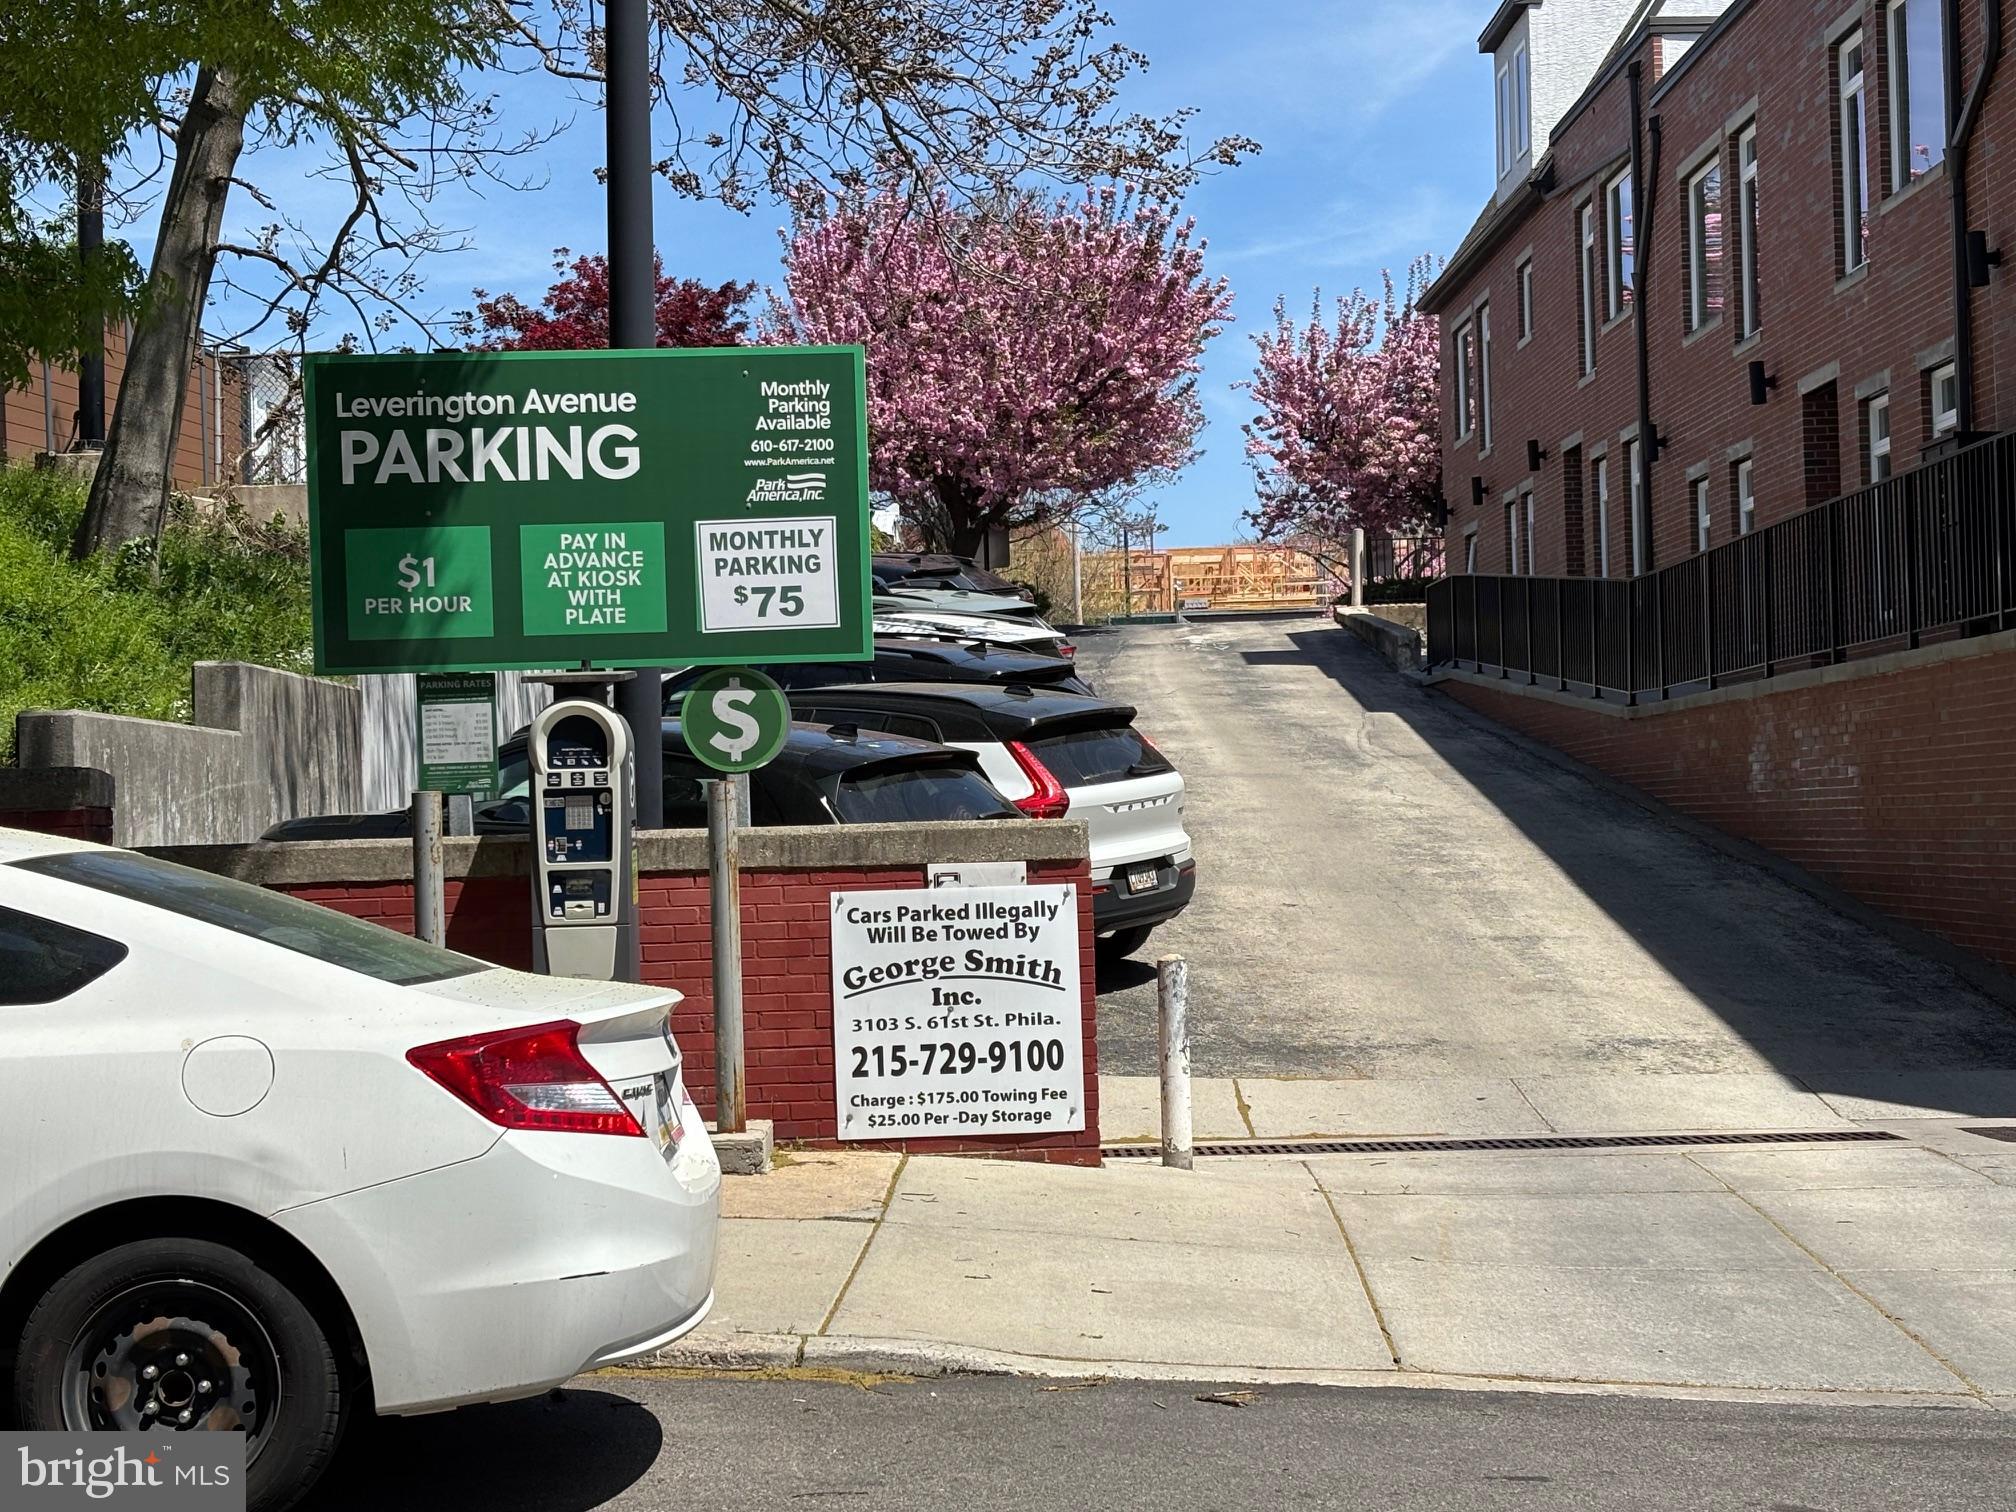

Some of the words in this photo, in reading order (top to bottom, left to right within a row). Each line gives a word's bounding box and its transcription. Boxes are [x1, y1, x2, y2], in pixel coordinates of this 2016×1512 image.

[761, 380, 830, 399] Monthly
[335, 390, 515, 422] Leverington
[523, 388, 637, 414] Avenue
[769, 398, 830, 416] Parking
[756, 414, 831, 430] Available
[341, 424, 641, 485] PARKING
[751, 439, 834, 452] 610-617-2100
[744, 457, 835, 466] www.ParkAmerica.net
[756, 479, 785, 491] Park
[560, 533, 598, 550] PAY
[604, 533, 626, 548] IN
[709, 529, 824, 552] MONTHLY
[543, 551, 644, 569] ADVANCE
[714, 555, 821, 577] PARKING
[398, 553, 436, 593] $1
[548, 571, 572, 588] AT
[577, 570, 642, 587] KIOSK
[365, 598, 403, 615] PER
[410, 596, 472, 614] HOUR
[568, 589, 621, 606] WITH
[734, 585, 805, 619] $75
[566, 608, 626, 625] PLATE
[420, 680, 460, 689] PARKING
[463, 679, 492, 688] RATES
[847, 907, 891, 924] Cars
[897, 903, 969, 922] Parked
[976, 900, 1058, 922] Illegally
[867, 926, 906, 944] Will
[912, 926, 938, 942] Be
[942, 923, 1008, 941] Towed
[1014, 922, 1040, 942] By
[843, 954, 956, 990] George
[964, 949, 1062, 984] Smith
[932, 987, 982, 1006] Inc.
[852, 1018, 898, 1032] 3103
[905, 1018, 922, 1030] S.
[927, 1016, 968, 1029] 61st
[974, 1014, 999, 1028] St.
[1005, 1012, 1061, 1026] Phila.
[852, 1038, 1064, 1078] 215-729-9100
[917, 1090, 978, 1106] $175.00
[982, 1090, 1038, 1104] Towing
[1042, 1088, 1068, 1100] Fee
[868, 1114, 920, 1127] $25.00
[924, 1112, 949, 1124] Per
[992, 1110, 1051, 1124] Storage
